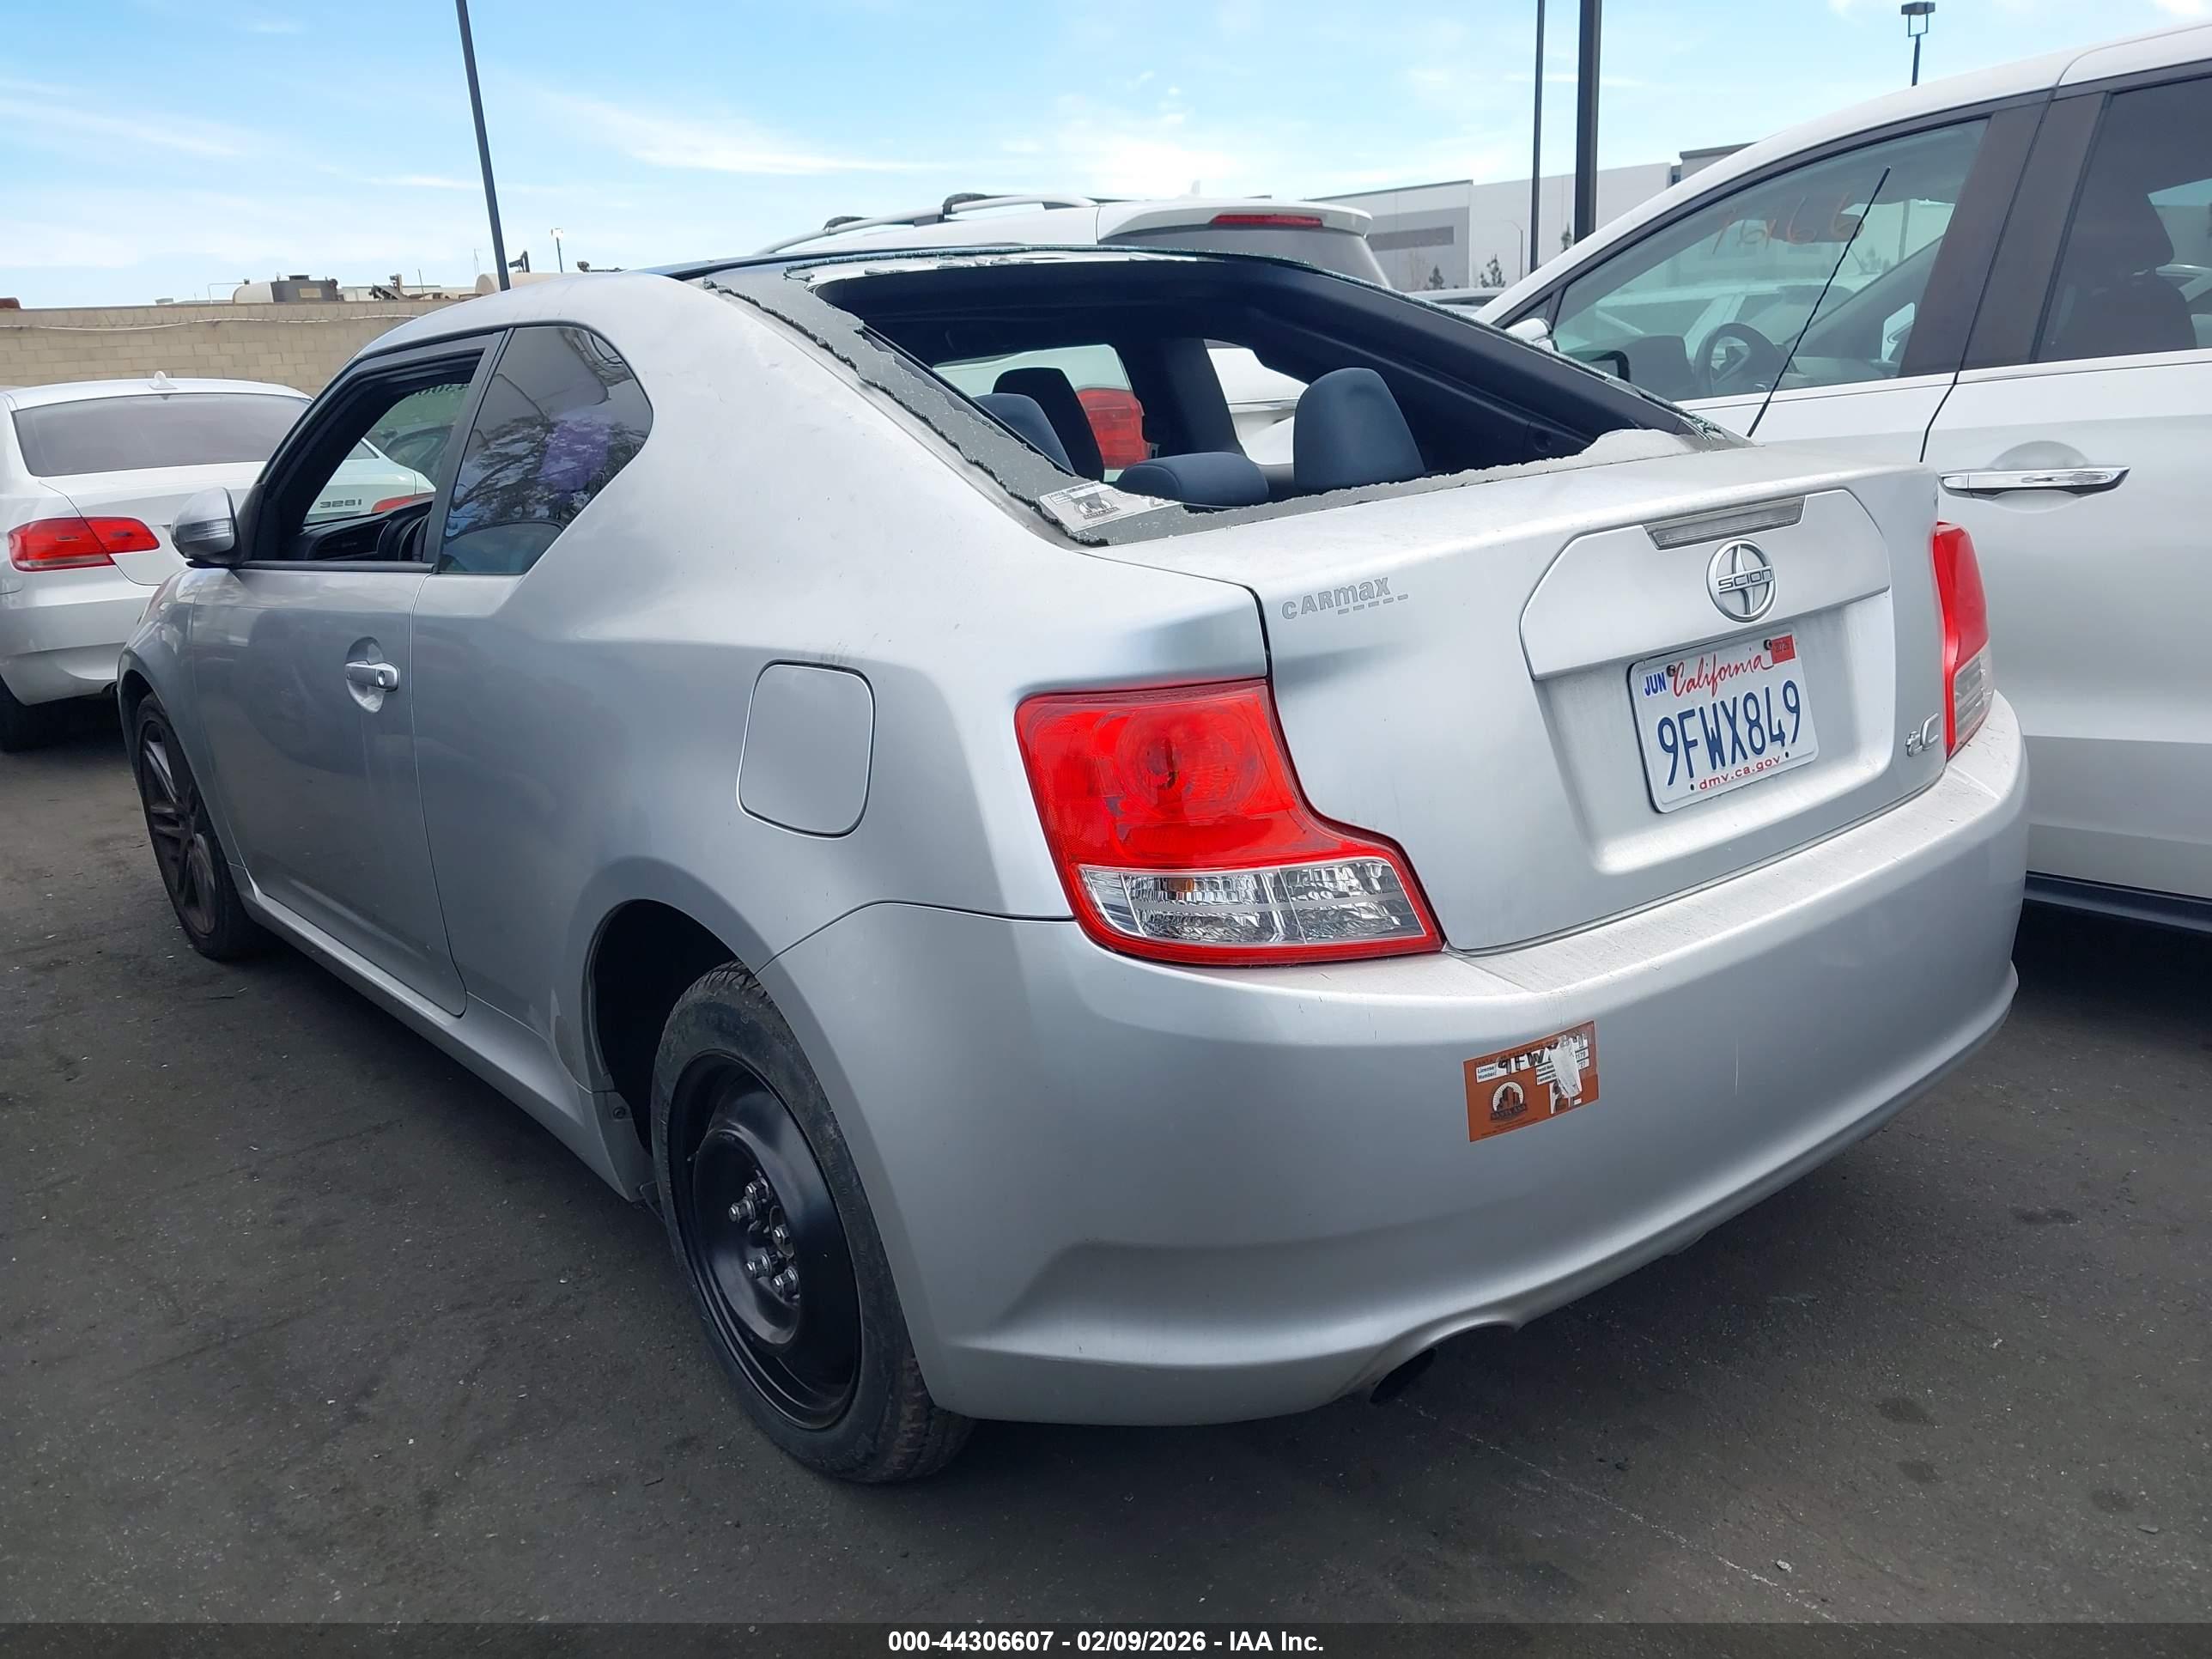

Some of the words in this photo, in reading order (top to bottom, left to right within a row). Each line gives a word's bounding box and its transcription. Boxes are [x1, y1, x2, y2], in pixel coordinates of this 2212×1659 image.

[1718, 568, 1772, 591] SCION
[1644, 672, 1667, 697] JUN
[1673, 647, 1773, 697] California
[1657, 679, 1801, 787] 9FWX849
[1698, 754, 1781, 791] dmv.ca.gov
